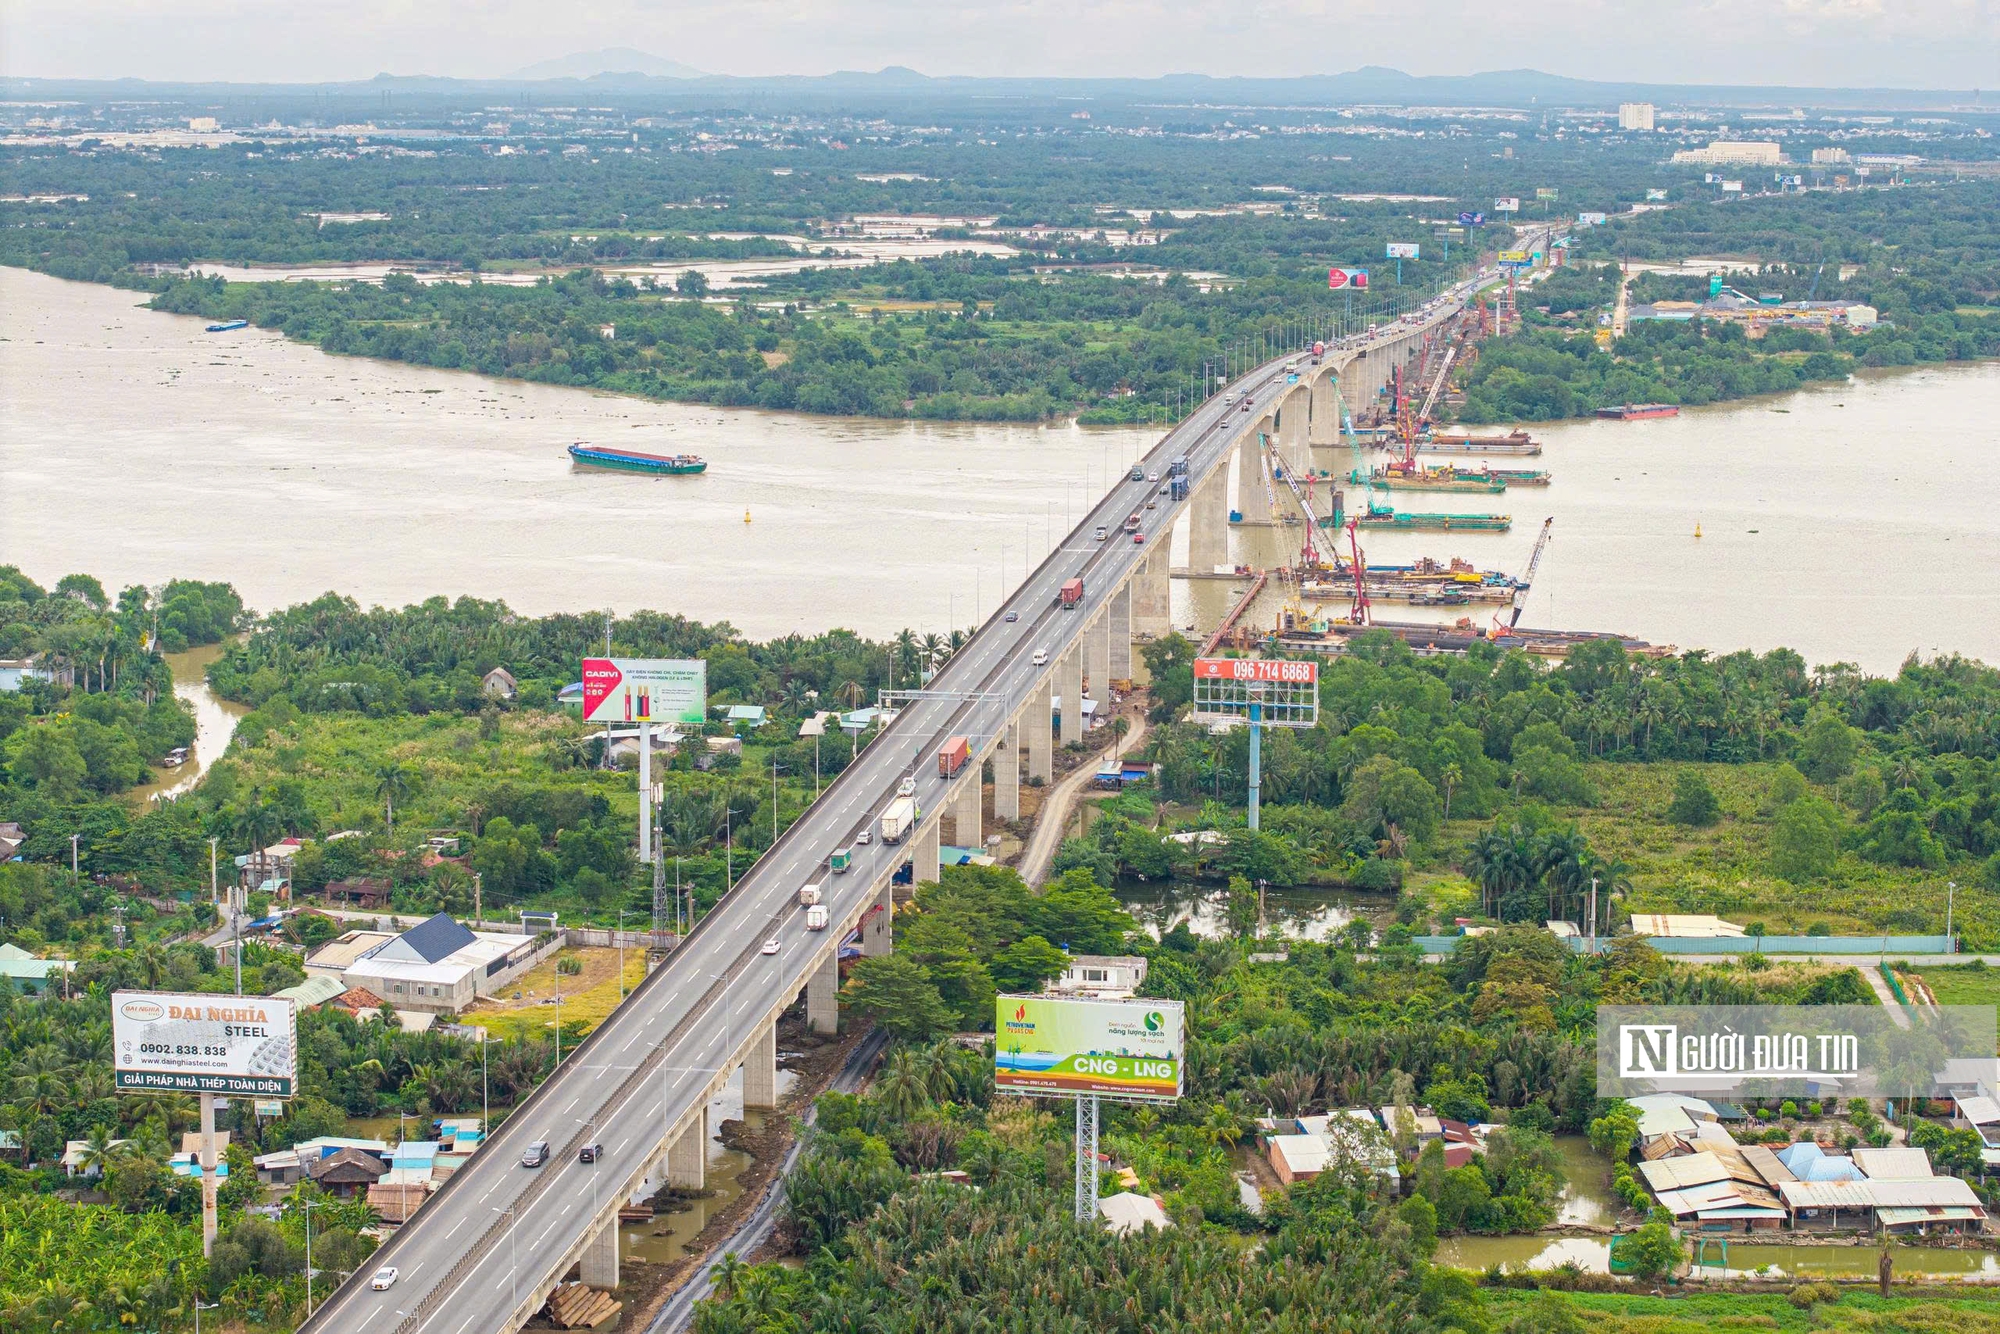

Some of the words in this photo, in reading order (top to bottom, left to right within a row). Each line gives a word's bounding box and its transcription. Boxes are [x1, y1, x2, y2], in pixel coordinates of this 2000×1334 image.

[586, 670, 618, 678] CADIVI
[1234, 661, 1255, 678] 096
[1258, 662, 1279, 679] 714
[1282, 663, 1310, 681] 6868
[207, 1005, 268, 1024] NGHĨA
[225, 1025, 269, 1038] STEEL
[1108, 1028, 1126, 1036] năng
[1127, 1029, 1147, 1037] lượng
[1148, 1030, 1165, 1038] sạch
[141, 1057, 228, 1068] www.dainghiasteel.com
[1074, 1057, 1118, 1075] CNG
[1134, 1061, 1172, 1079] LNG
[124, 1073, 144, 1084] GIẢI
[146, 1073, 174, 1086] PHÁP
[176, 1075, 198, 1087] NHÀ
[200, 1076, 226, 1088] THÉP
[227, 1077, 256, 1090] TOÀN
[258, 1079, 282, 1092] DIỆN
